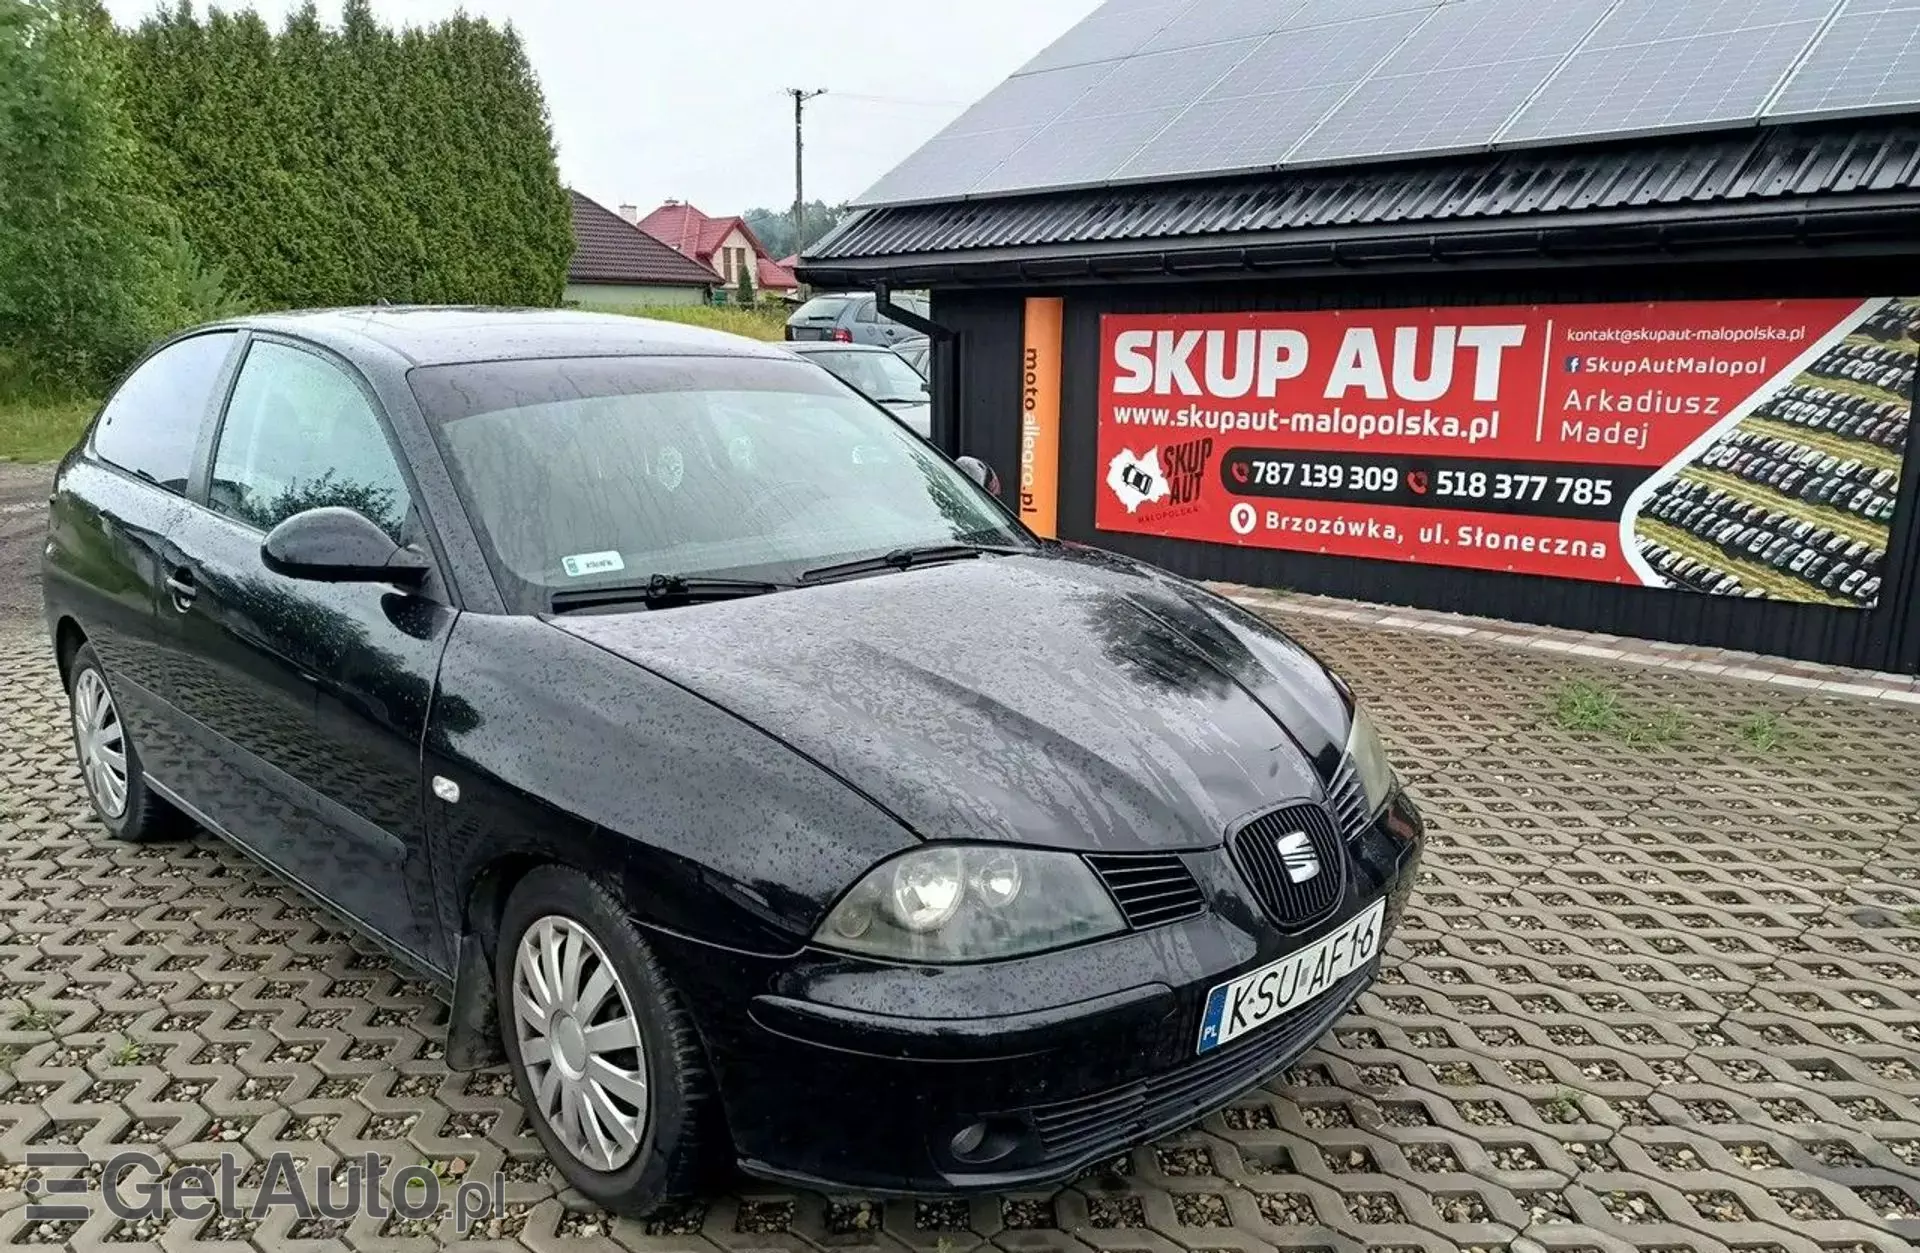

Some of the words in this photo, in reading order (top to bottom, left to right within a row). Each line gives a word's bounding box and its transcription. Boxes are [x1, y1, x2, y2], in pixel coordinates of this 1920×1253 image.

[1567, 325, 1806, 343] kontakt@skupaut-malopolska.pl
[1113, 329, 1309, 399] SKUP
[1323, 324, 1526, 401] AUT
[1586, 356, 1766, 376] SkupAutMalopol
[1563, 388, 1720, 415] Arkadiusz
[1113, 404, 1499, 444] www.skupaut-malopolska.pl
[1561, 420, 1649, 449] Madej
[1163, 437, 1213, 479] SKUP
[1169, 471, 1204, 506] AUT
[1252, 460, 1295, 486] 787
[1300, 463, 1343, 488] 139
[1349, 466, 1398, 492] 309
[1436, 470, 1487, 498] 518
[1493, 473, 1548, 502] 377
[1555, 477, 1613, 506] 785
[1265, 511, 1404, 544] Brzozówka,
[1419, 525, 1450, 546] ul.
[1457, 527, 1607, 559] Słoneczna
[1227, 957, 1303, 1035] KSU
[1307, 911, 1376, 996] AF16
[1203, 1026, 1217, 1041] PL
